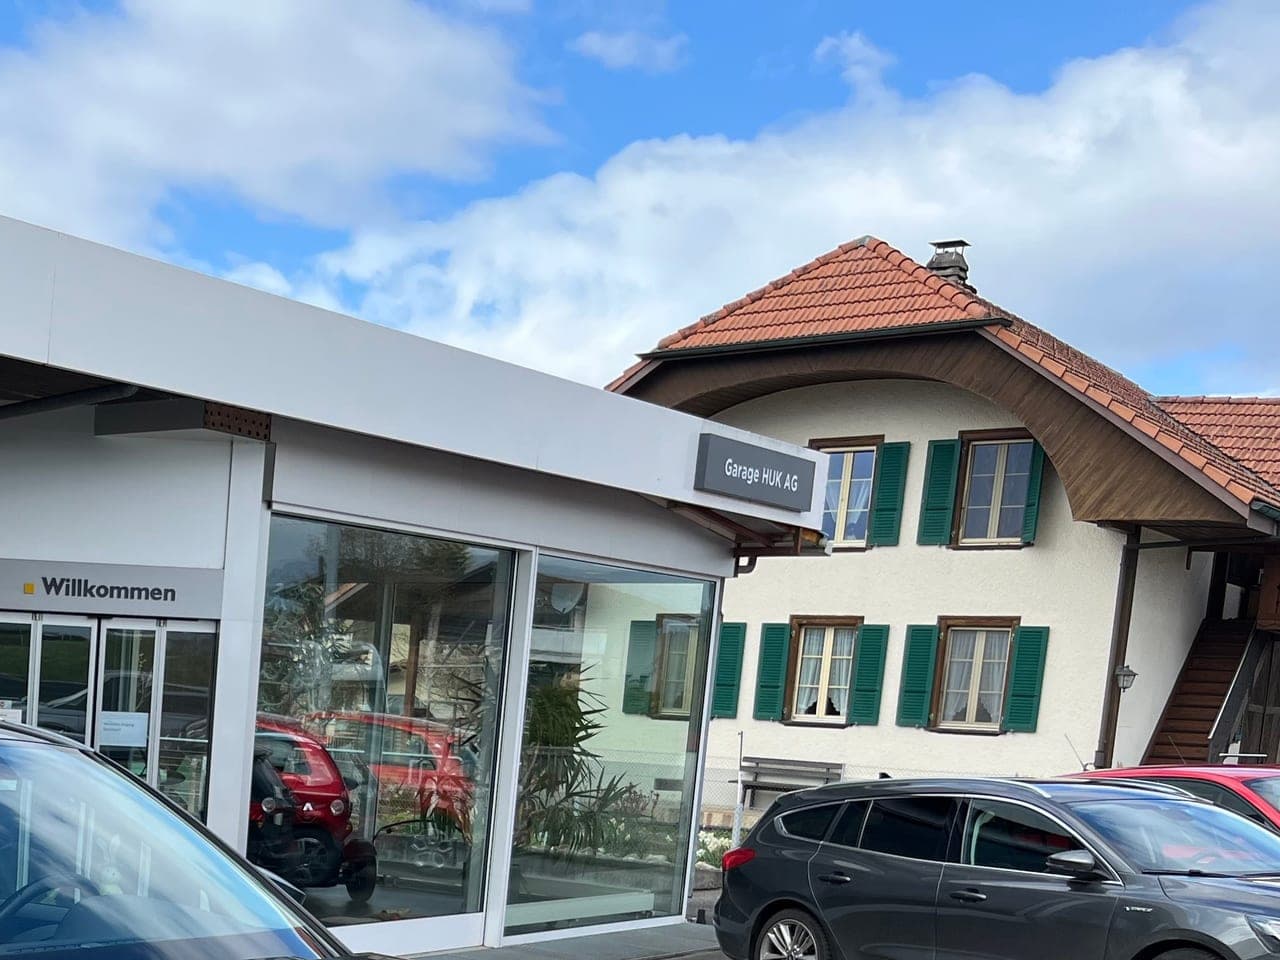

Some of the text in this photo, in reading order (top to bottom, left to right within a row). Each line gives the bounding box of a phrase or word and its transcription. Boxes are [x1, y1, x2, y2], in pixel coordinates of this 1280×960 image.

[725, 458, 798, 492] Garage HUK AG
[41, 576, 176, 602] Willkommen
